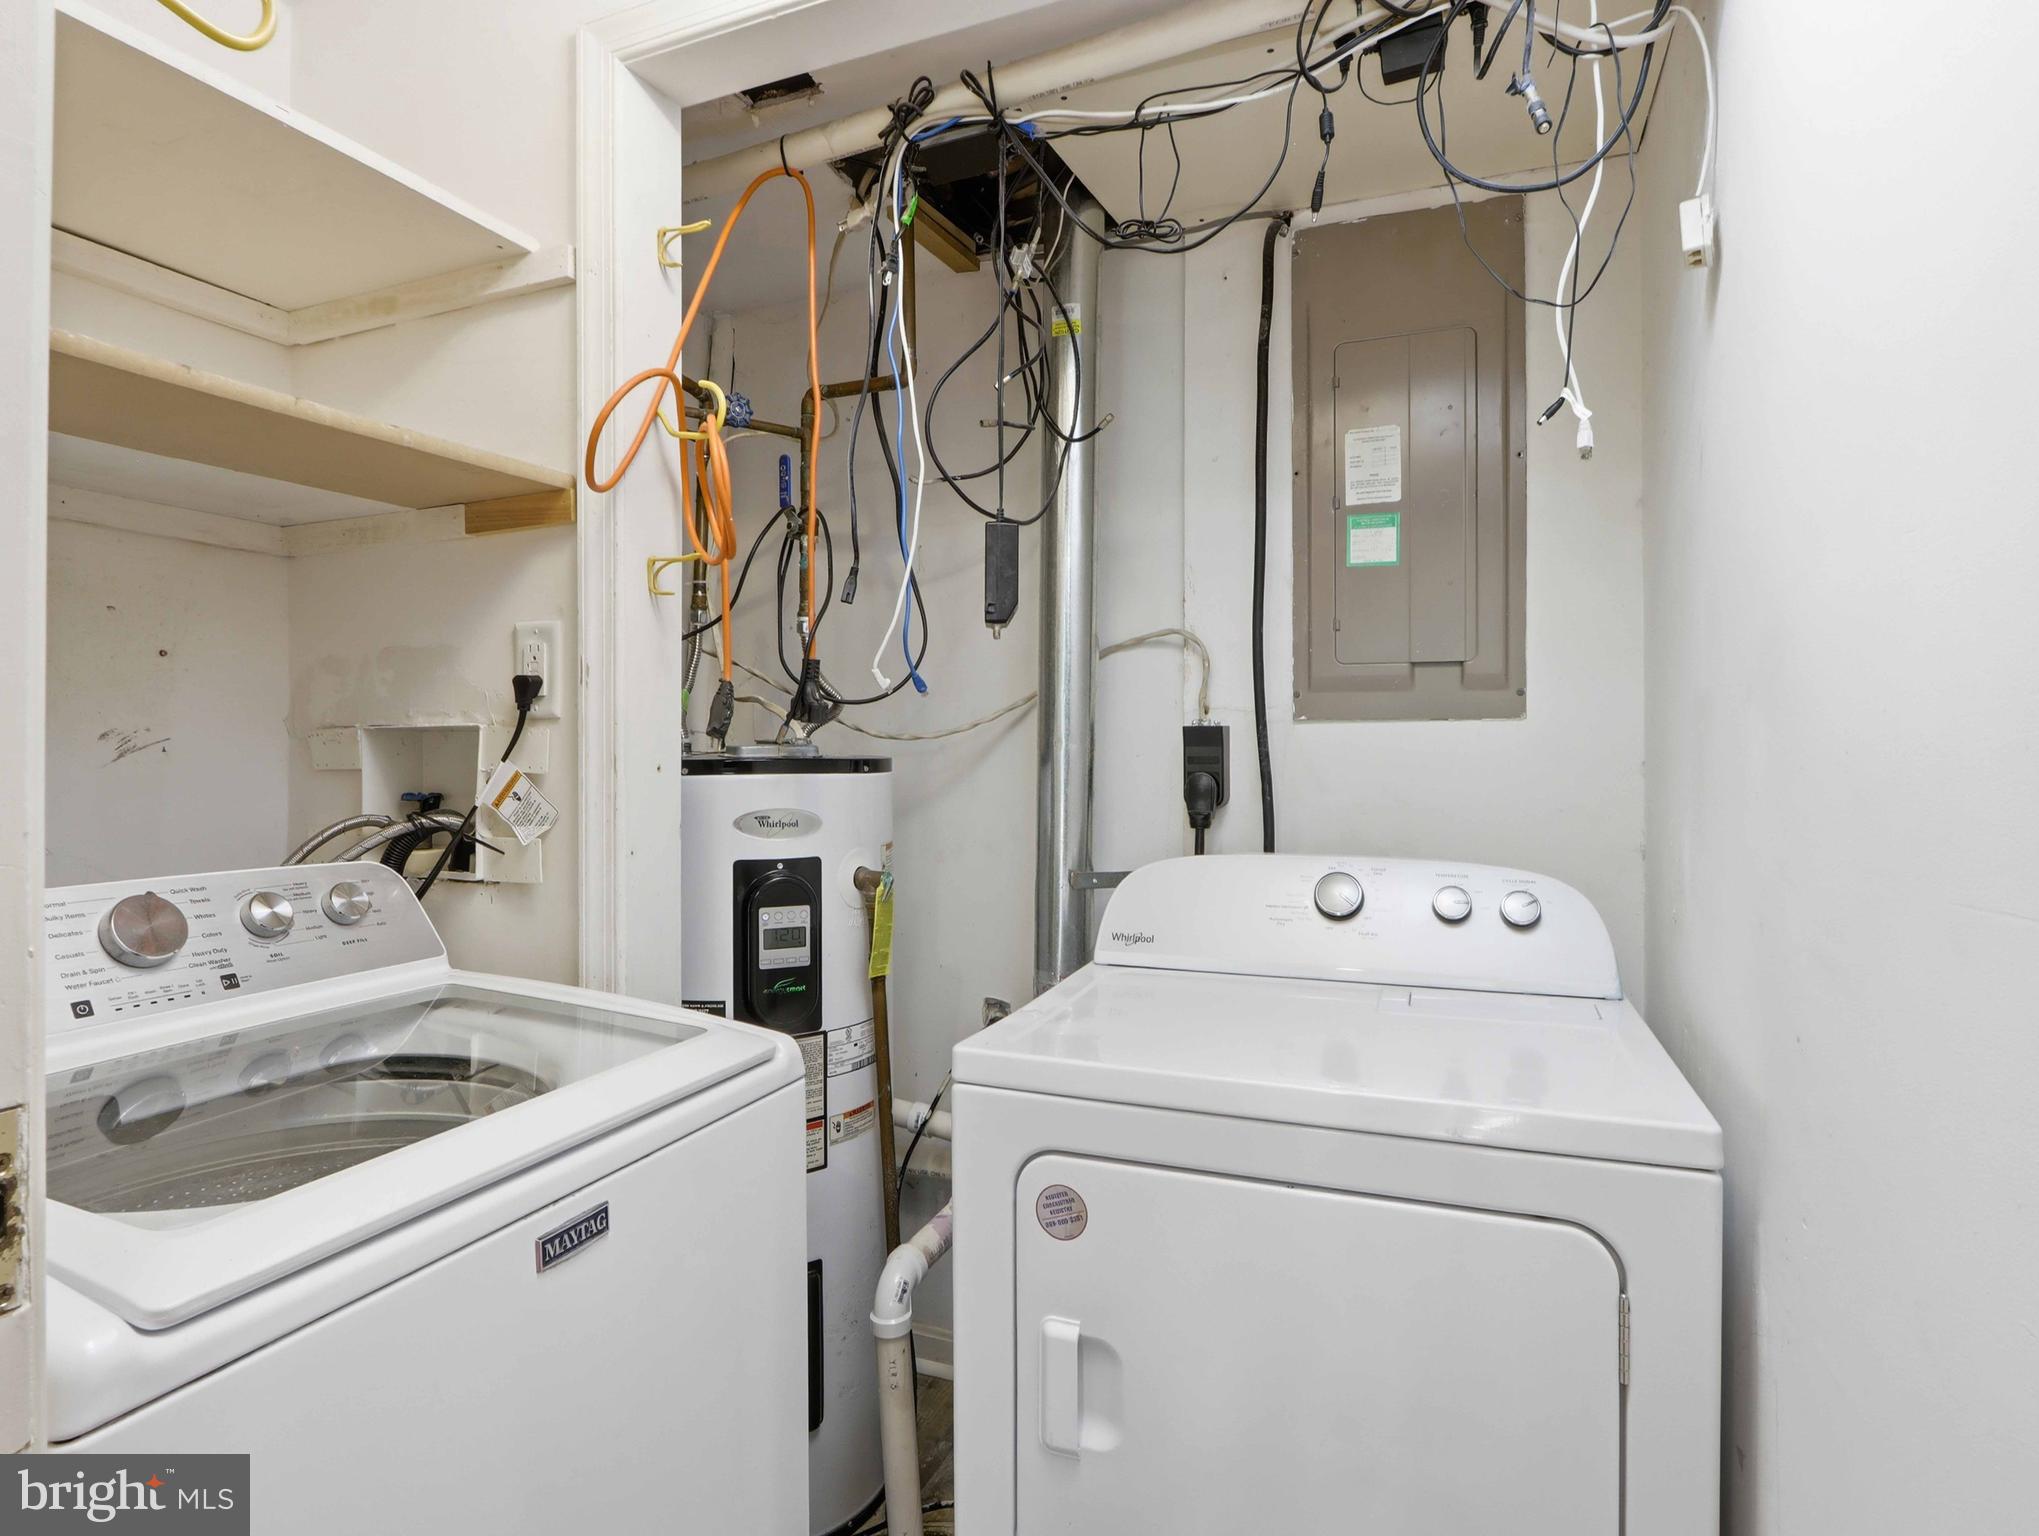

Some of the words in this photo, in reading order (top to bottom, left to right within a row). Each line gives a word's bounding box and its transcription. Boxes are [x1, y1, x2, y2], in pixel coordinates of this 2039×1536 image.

[757, 818, 799, 831] Whirlpool
[44, 901, 66, 909] ormal
[48, 930, 84, 940] Delicates
[201, 931, 223, 939] Colors
[1111, 931, 1155, 946] Whirlpool
[54, 952, 85, 961] Casuals
[60, 969, 81, 979] Drain
[88, 966, 106, 976] Spin
[64, 981, 87, 991] Water
[88, 978, 114, 987] Faucet
[544, 1212, 608, 1262] MAYTAG
